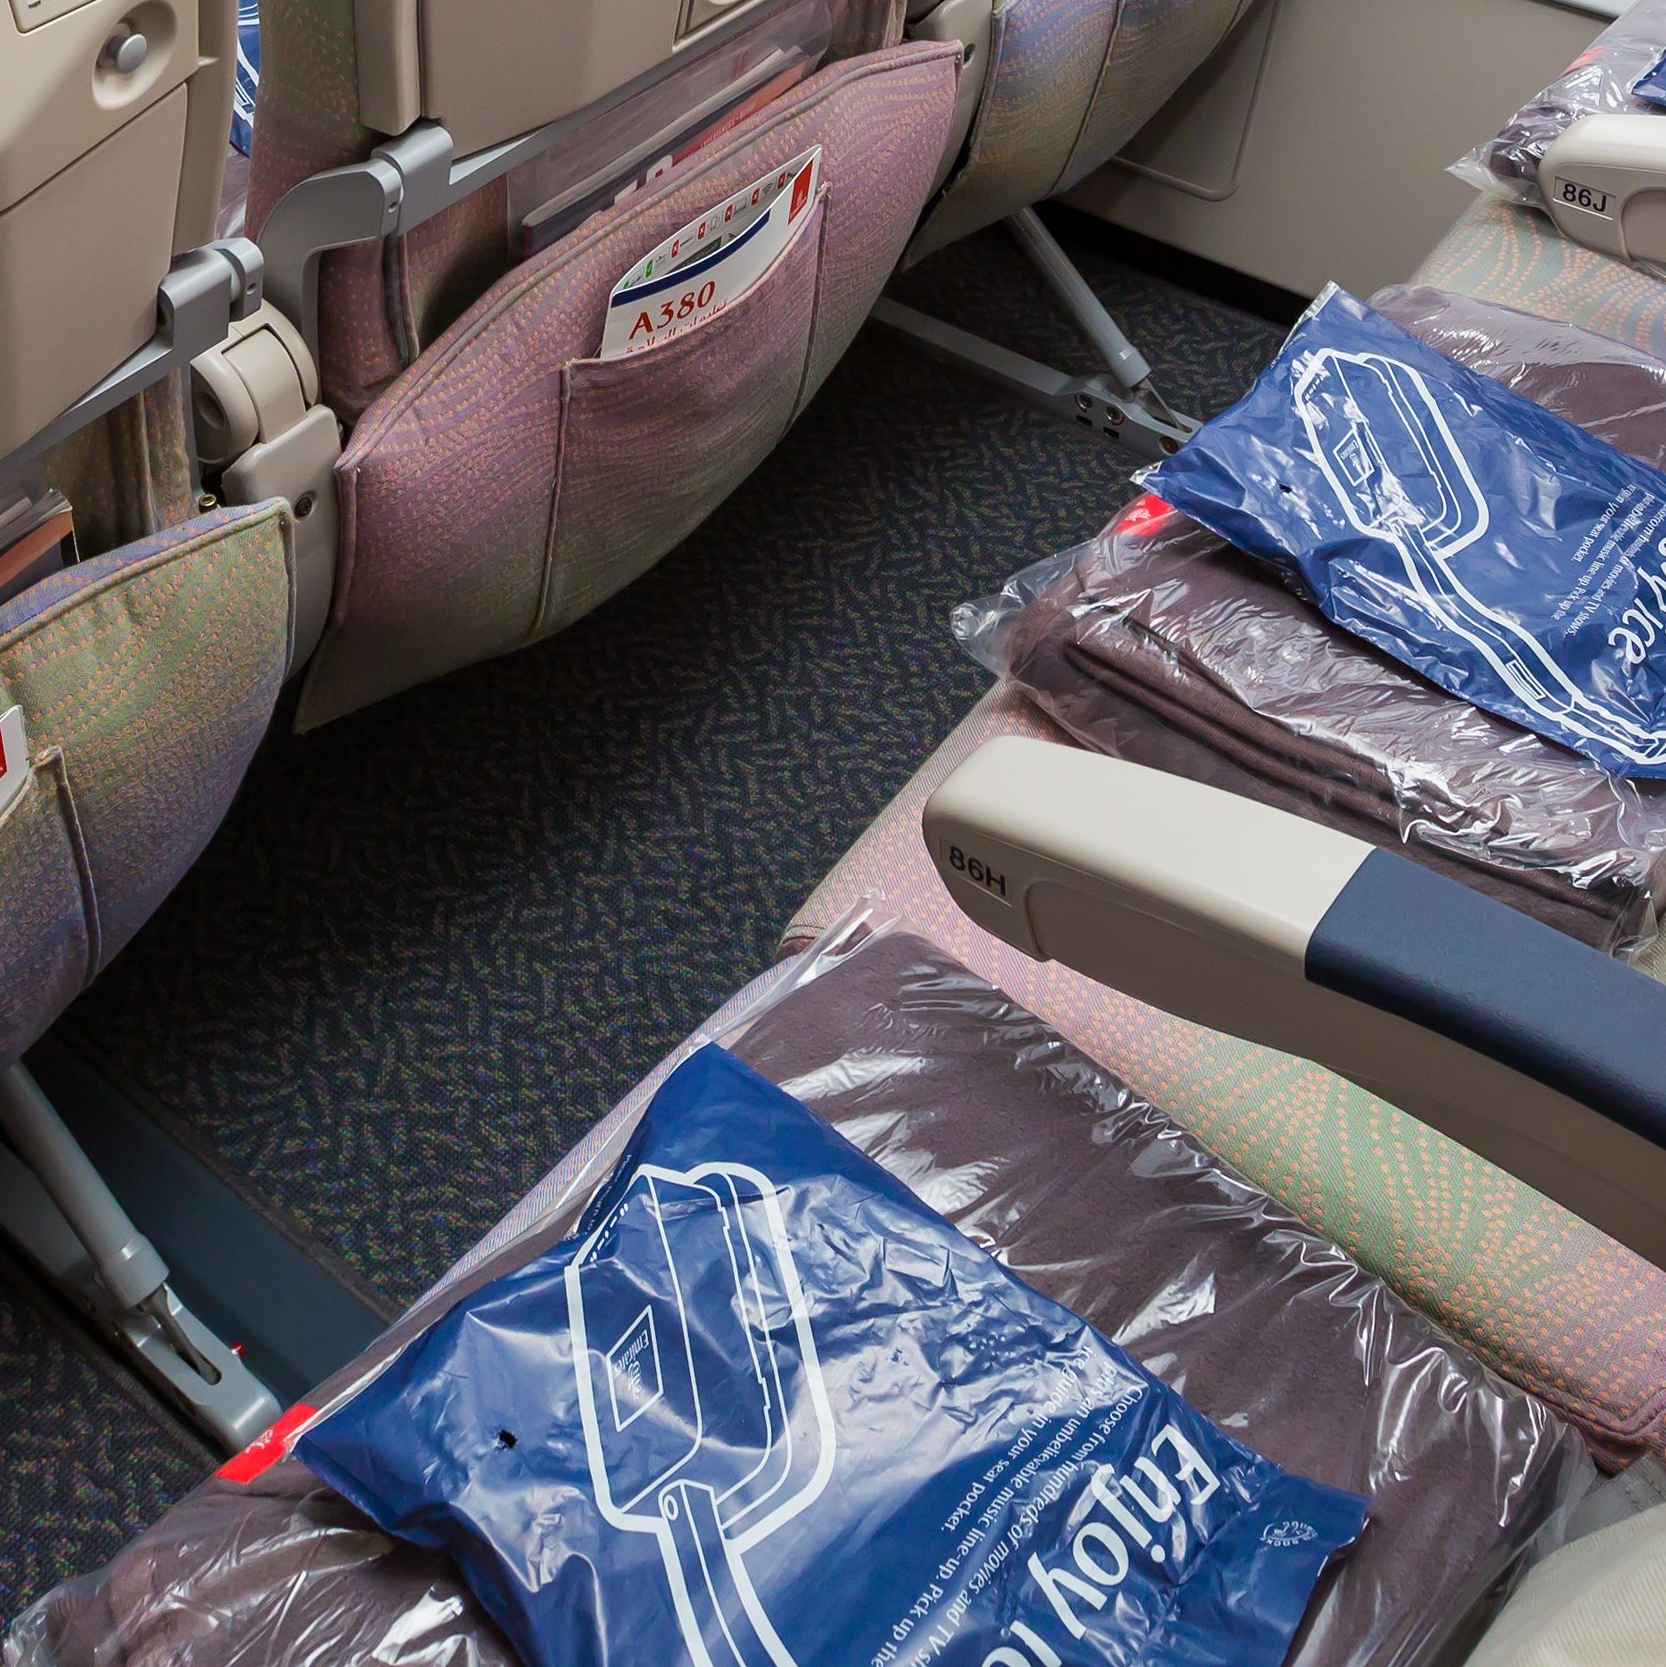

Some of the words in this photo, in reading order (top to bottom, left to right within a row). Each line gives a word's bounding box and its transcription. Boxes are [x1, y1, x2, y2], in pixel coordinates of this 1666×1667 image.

[1562, 183, 1607, 212] 86J
[629, 280, 716, 341] A380
[1589, 521, 1606, 538] seat
[1596, 539, 1617, 563] music
[1601, 562, 1624, 590] movies
[1558, 596, 1573, 611] up
[1584, 600, 1601, 615] TV
[949, 845, 1006, 897] 86H
[1041, 1365, 1079, 1414] guide
[1077, 1395, 1096, 1420] an
[1101, 1382, 1145, 1433] Choose
[1032, 1408, 1055, 1431] in
[1007, 1425, 1039, 1465] your
[1014, 1415, 1084, 1491] unbelievable
[1078, 1428, 1110, 1464] from
[981, 1459, 1012, 1487] seat
[939, 1481, 988, 1534] pocket.
[977, 1486, 1016, 1527] music
[1021, 1459, 1081, 1531] hundreds
[1010, 1524, 1032, 1551] of
[1027, 1423, 1221, 1641] Enjoy
[935, 1526, 988, 1582] line-up.
[968, 1541, 1012, 1596] movies
[909, 1583, 945, 1620] Pick
[945, 1592, 974, 1626] and
[893, 1616, 917, 1645] up
[928, 1621, 957, 1657] TV
[870, 1639, 900, 1667] the
